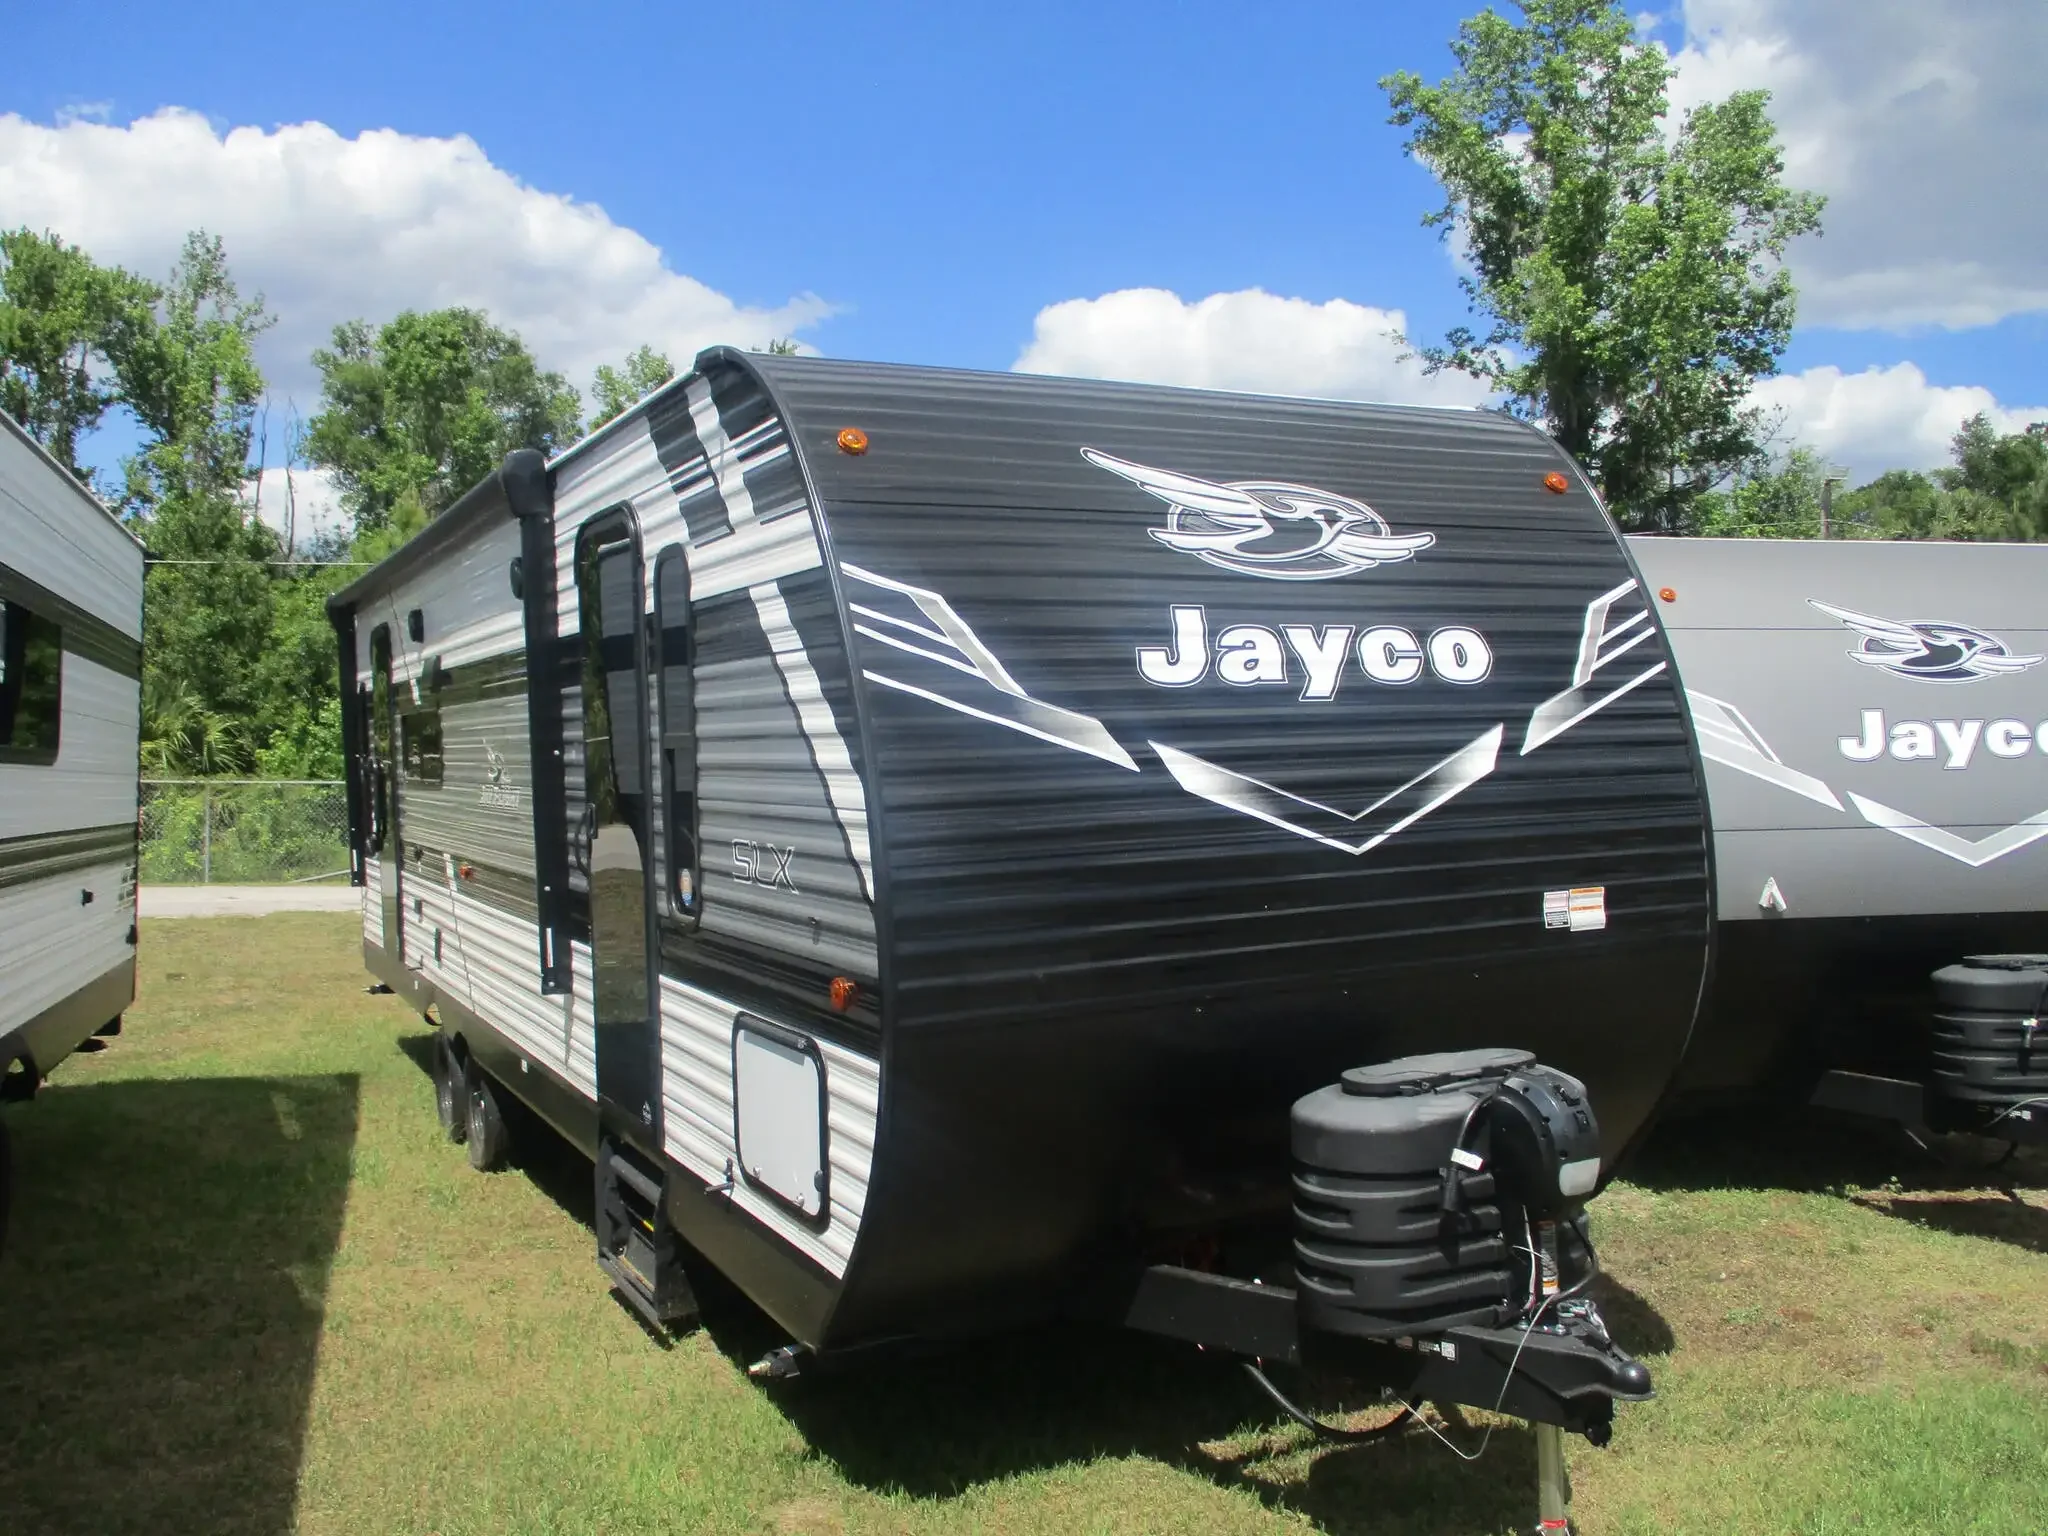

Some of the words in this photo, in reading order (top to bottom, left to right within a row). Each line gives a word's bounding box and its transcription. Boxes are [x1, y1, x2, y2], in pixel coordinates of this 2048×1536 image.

[1136, 604, 1493, 702] Jayco
[1837, 708, 2048, 770] Jayc
[732, 838, 800, 895] SLX
